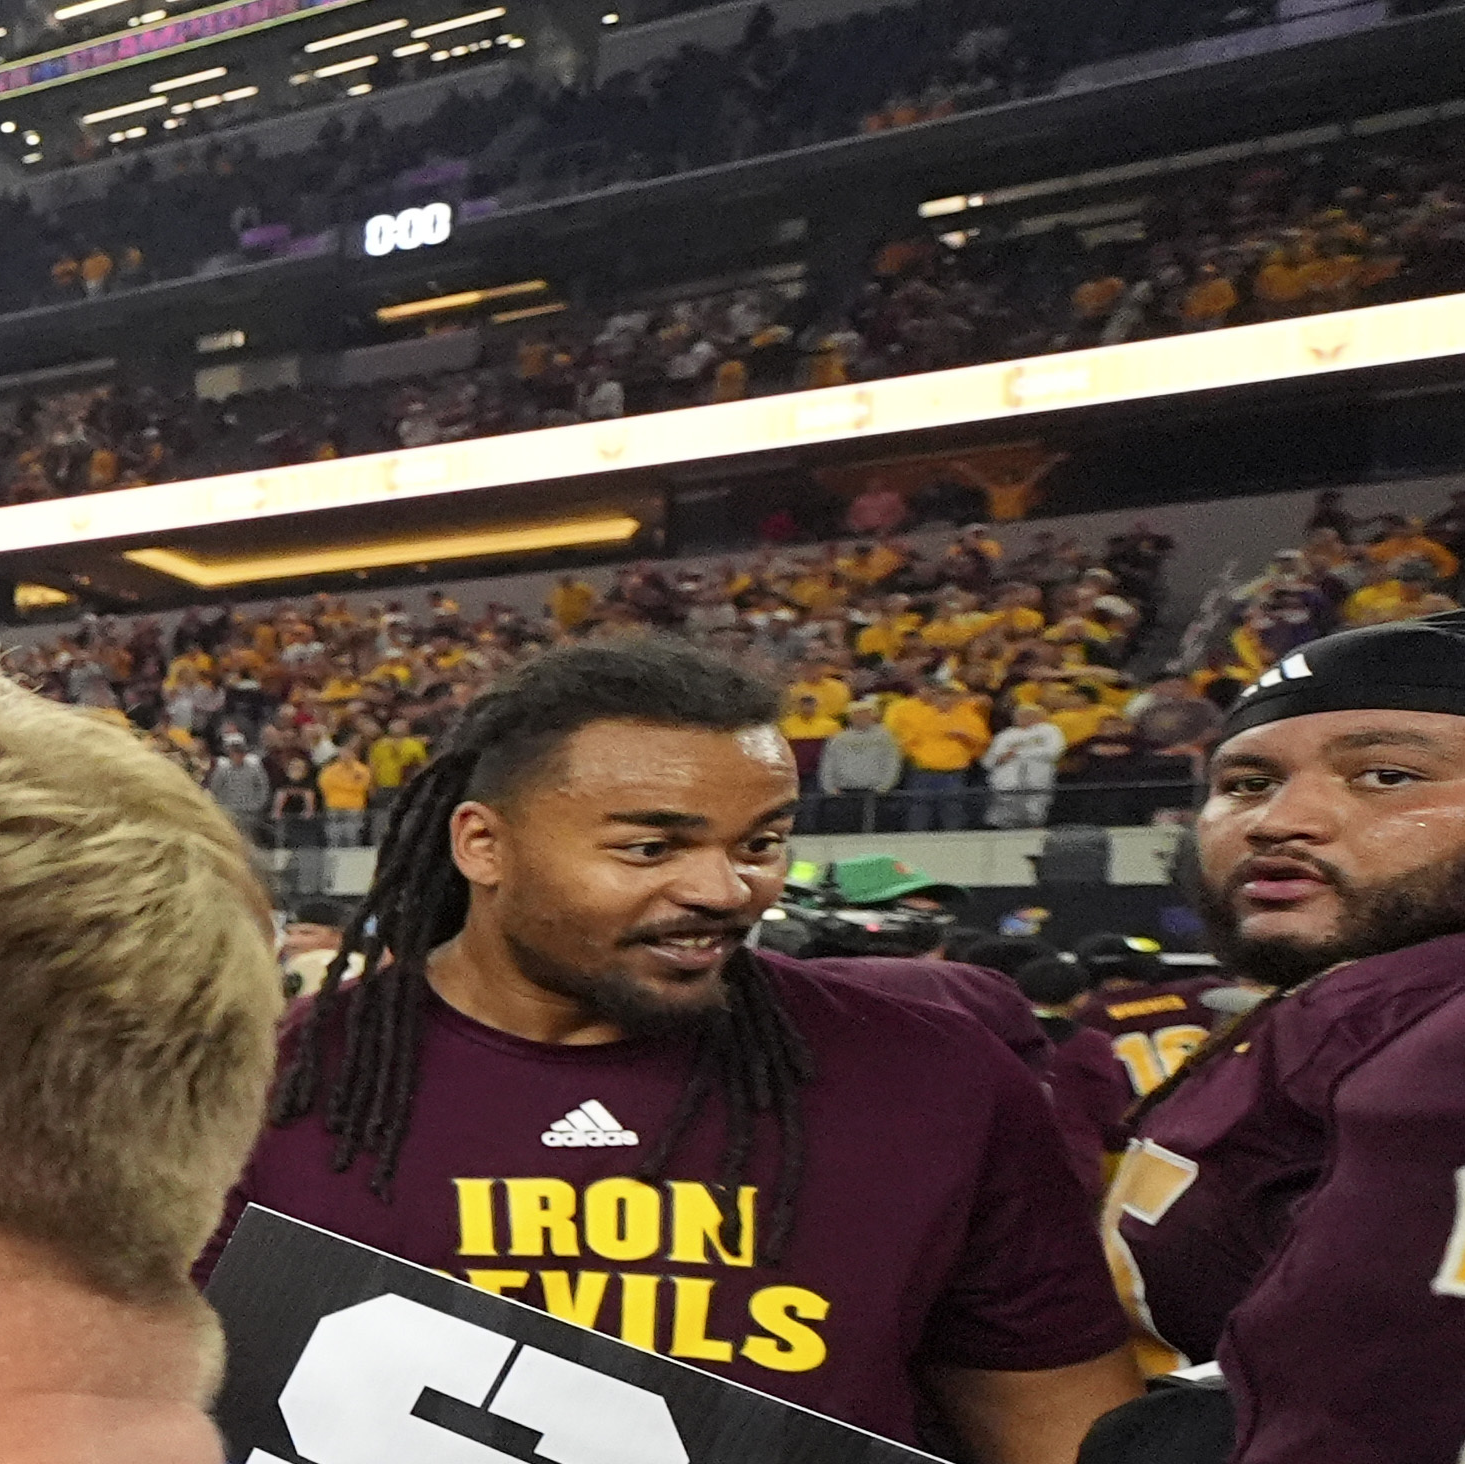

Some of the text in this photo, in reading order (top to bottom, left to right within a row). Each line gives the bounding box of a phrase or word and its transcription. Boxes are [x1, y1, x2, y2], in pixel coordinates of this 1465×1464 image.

[540, 1127, 639, 1148] adidas
[452, 1176, 759, 1268] IRON
[432, 1268, 830, 1372] VILS
